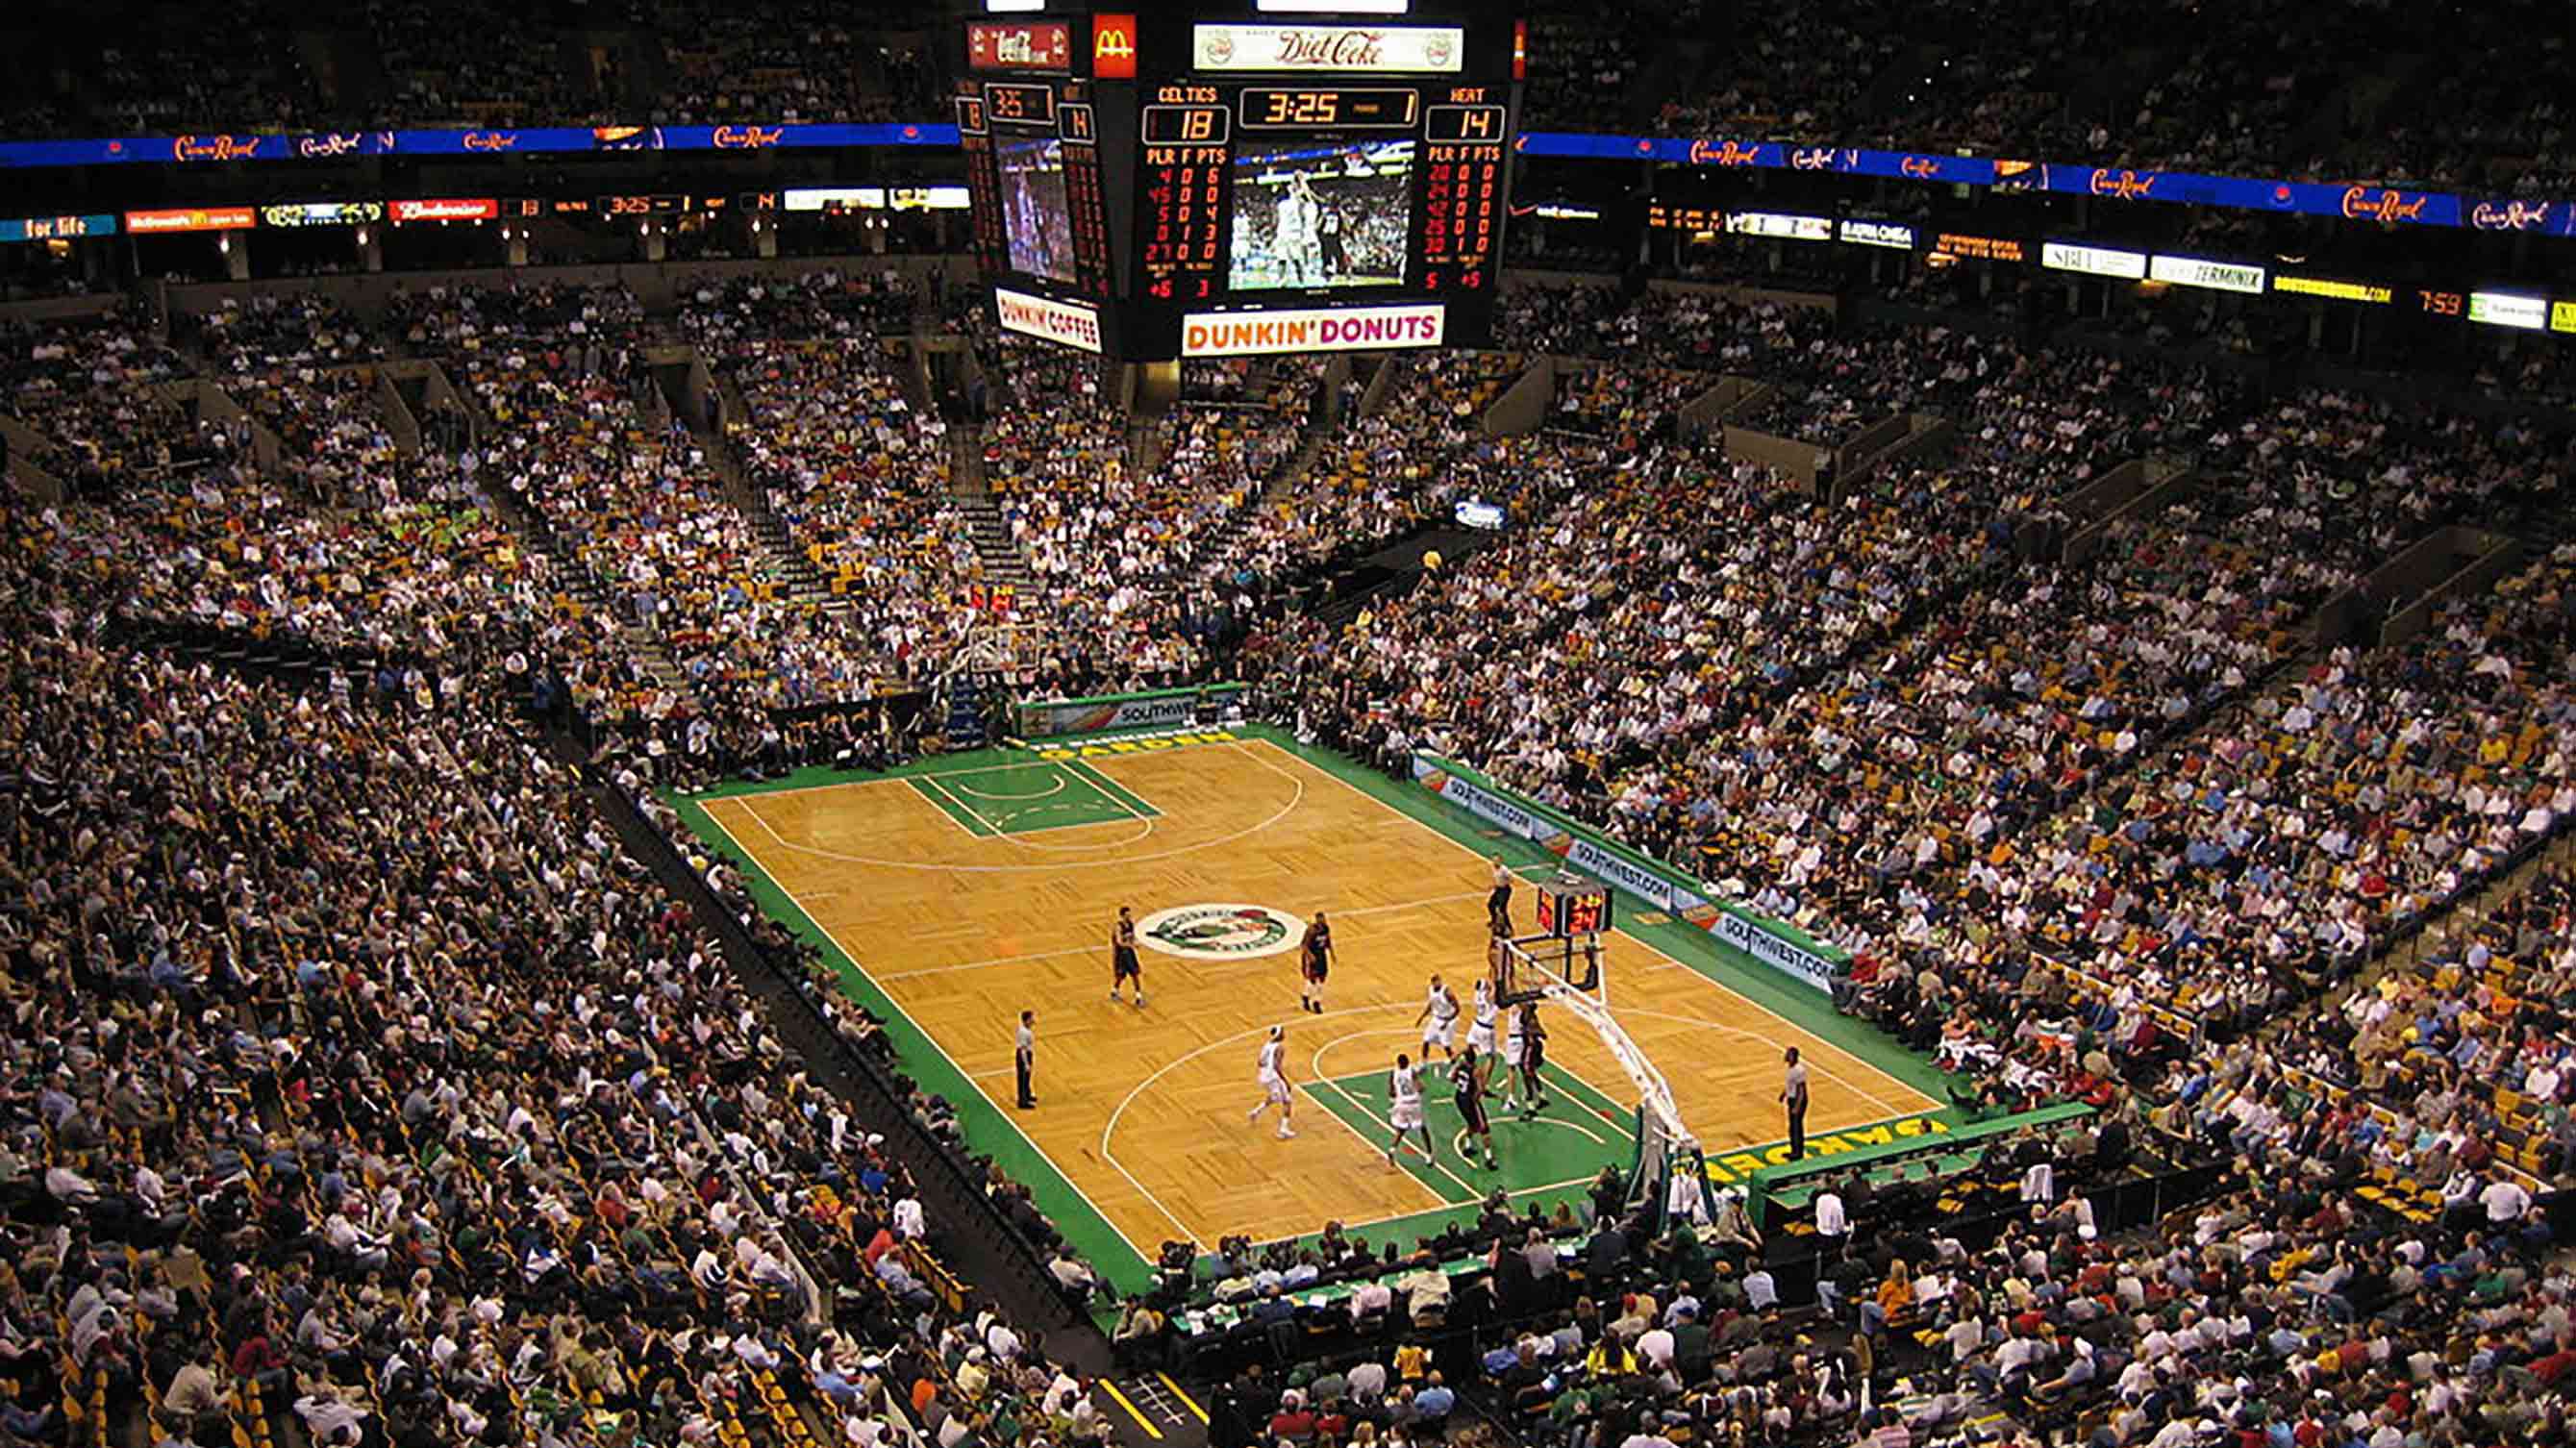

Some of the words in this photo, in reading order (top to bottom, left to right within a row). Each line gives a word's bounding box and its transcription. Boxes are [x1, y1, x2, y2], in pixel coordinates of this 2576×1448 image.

[1277, 32, 1333, 64] Diet
[1333, 31, 1384, 65] Coke
[1159, 87, 1217, 103] CELTICS
[1450, 87, 1486, 103] HEAT
[1265, 93, 1338, 123] 3:25
[1405, 93, 1416, 123] 1
[1182, 110, 1213, 139] 18
[1461, 110, 1490, 137] 14
[1146, 148, 1176, 165] PLR
[1182, 148, 1192, 164] F
[1196, 147, 1226, 165] PTS
[1428, 146, 1455, 162] PLR
[1460, 146, 1470, 162] F
[1474, 146, 1500, 162] PTS
[1181, 167, 1193, 185] 0
[1458, 163, 1470, 181] 0
[1482, 163, 1494, 181] 0
[1179, 186, 1192, 204] 0
[1207, 186, 1217, 203] 0
[1457, 182, 1469, 199] 0
[1481, 182, 1493, 199] 0
[610, 196, 651, 213] 3:25
[1456, 200, 1467, 217] 0
[1480, 200, 1491, 216] 0
[1178, 205, 1190, 223] 0
[25, 218, 52, 238] for
[56, 215, 87, 237] life
[1184, 224, 1191, 241] 1
[1454, 218, 1465, 236] 0
[1478, 217, 1490, 235] 0
[1176, 243, 1189, 261] 0
[1203, 242, 1216, 261] 0
[1458, 237, 1464, 253] 1
[1476, 237, 1489, 253] 0
[2194, 264, 2262, 288] TERMINIX
[1048, 310, 1097, 345] COFFEE
[1187, 319, 1315, 351] DUNKIN'
[1319, 314, 1438, 344] DONUTS
[1576, 842, 1670, 901] SOUTHWEST.COM
